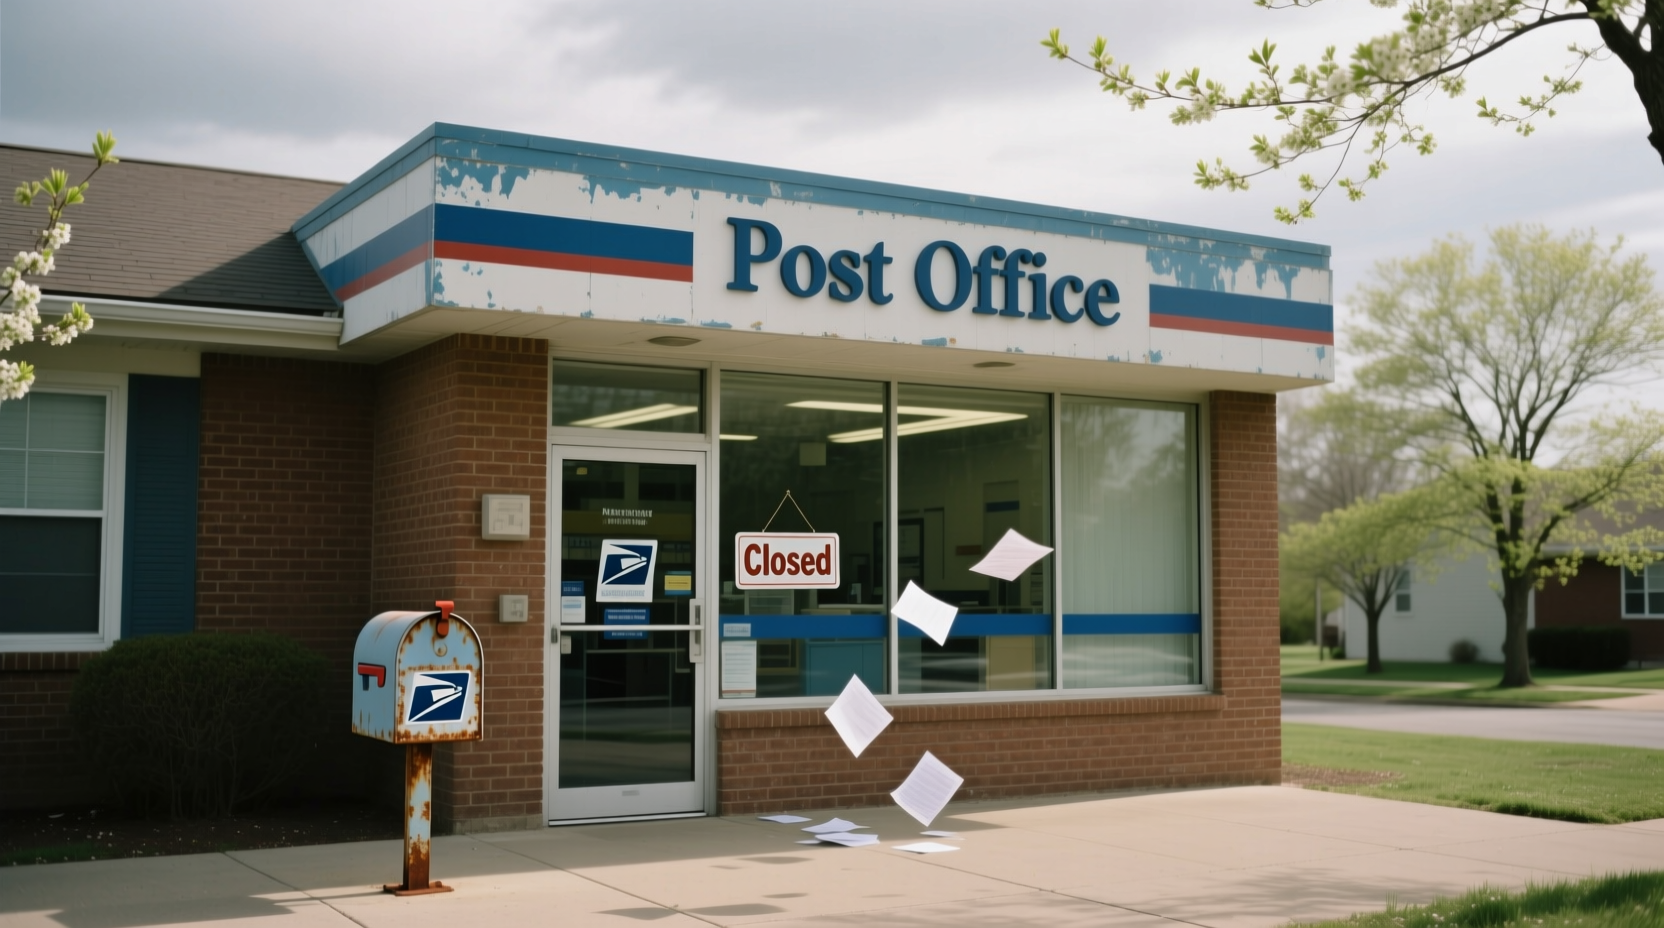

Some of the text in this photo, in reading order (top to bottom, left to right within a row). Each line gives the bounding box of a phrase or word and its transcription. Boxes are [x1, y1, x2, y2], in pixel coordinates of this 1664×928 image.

[726, 216, 1121, 327] Post Office
[744, 543, 831, 576] Closed
